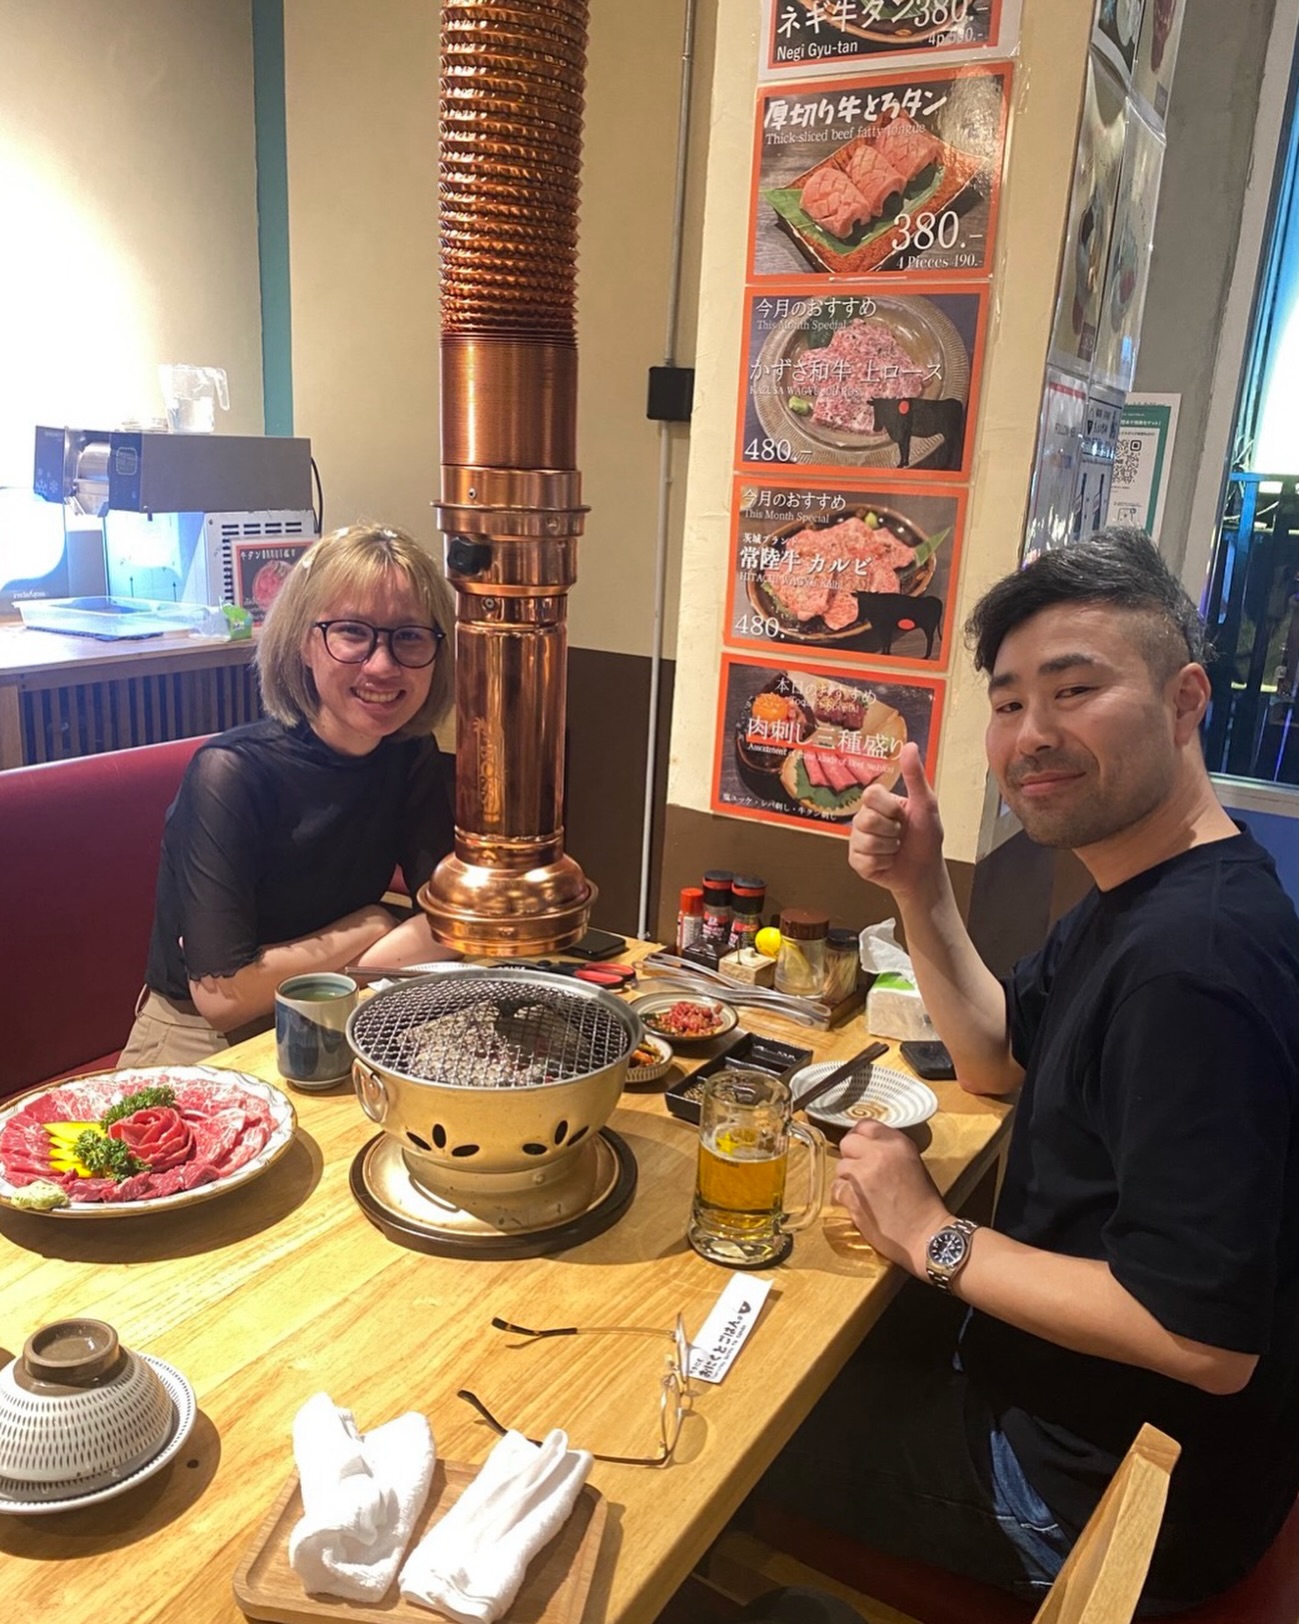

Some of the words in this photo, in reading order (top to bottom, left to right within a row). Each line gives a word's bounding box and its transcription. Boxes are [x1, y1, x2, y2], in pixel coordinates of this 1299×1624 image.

[777, 0, 914, 38] ネギ牛タン
[777, 44, 805, 61] Negi
[808, 41, 858, 59] Gyu-tan
[764, 88, 947, 130] 厚切り牛とろタン
[765, 130, 829, 145] Thick-sliced
[831, 127, 854, 140] beef
[857, 125, 882, 139] fatty
[892, 211, 983, 250] 380.-
[908, 255, 948, 268] Pieces
[756, 297, 877, 318] 今月のおすすめ
[756, 320, 776, 331] This
[812, 318, 847, 332] Special
[750, 359, 851, 382] かずさ和牛
[860, 362, 942, 383] 上ロース
[744, 438, 813, 462] 480.-
[742, 489, 846, 511] 今月のおすすめ
[745, 509, 763, 518] This
[765, 510, 794, 520] Month
[797, 512, 829, 523] Special
[740, 546, 801, 573] 常陸牛
[807, 553, 873, 576] カルビ
[734, 614, 800, 639] 480.-
[748, 718, 905, 761] 肉刺し三種盛り
